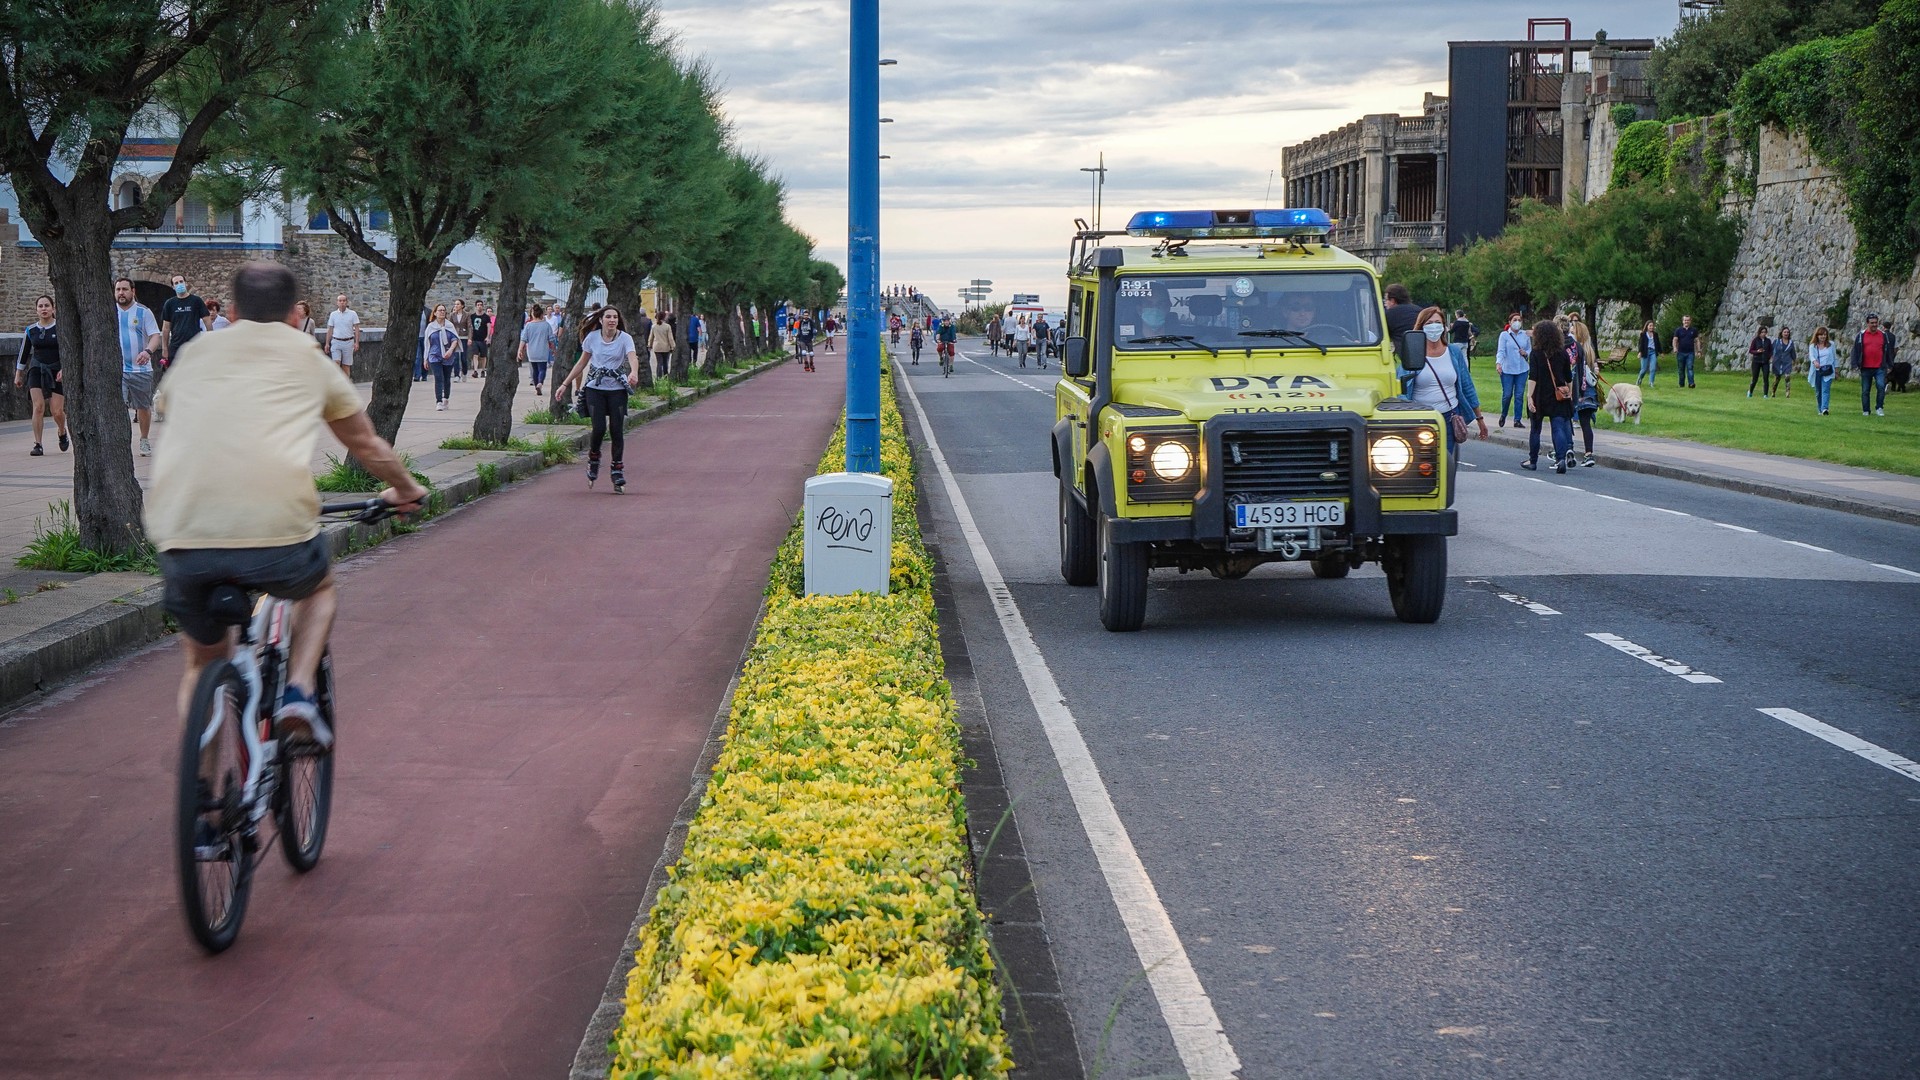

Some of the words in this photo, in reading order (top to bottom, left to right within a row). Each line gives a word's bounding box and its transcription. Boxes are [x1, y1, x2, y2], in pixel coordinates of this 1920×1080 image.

[1121, 280, 1151, 289] R-9.1
[1209, 375, 1331, 392] DYA
[1250, 506, 1297, 524] 4593
[1304, 505, 1339, 523] HCG
